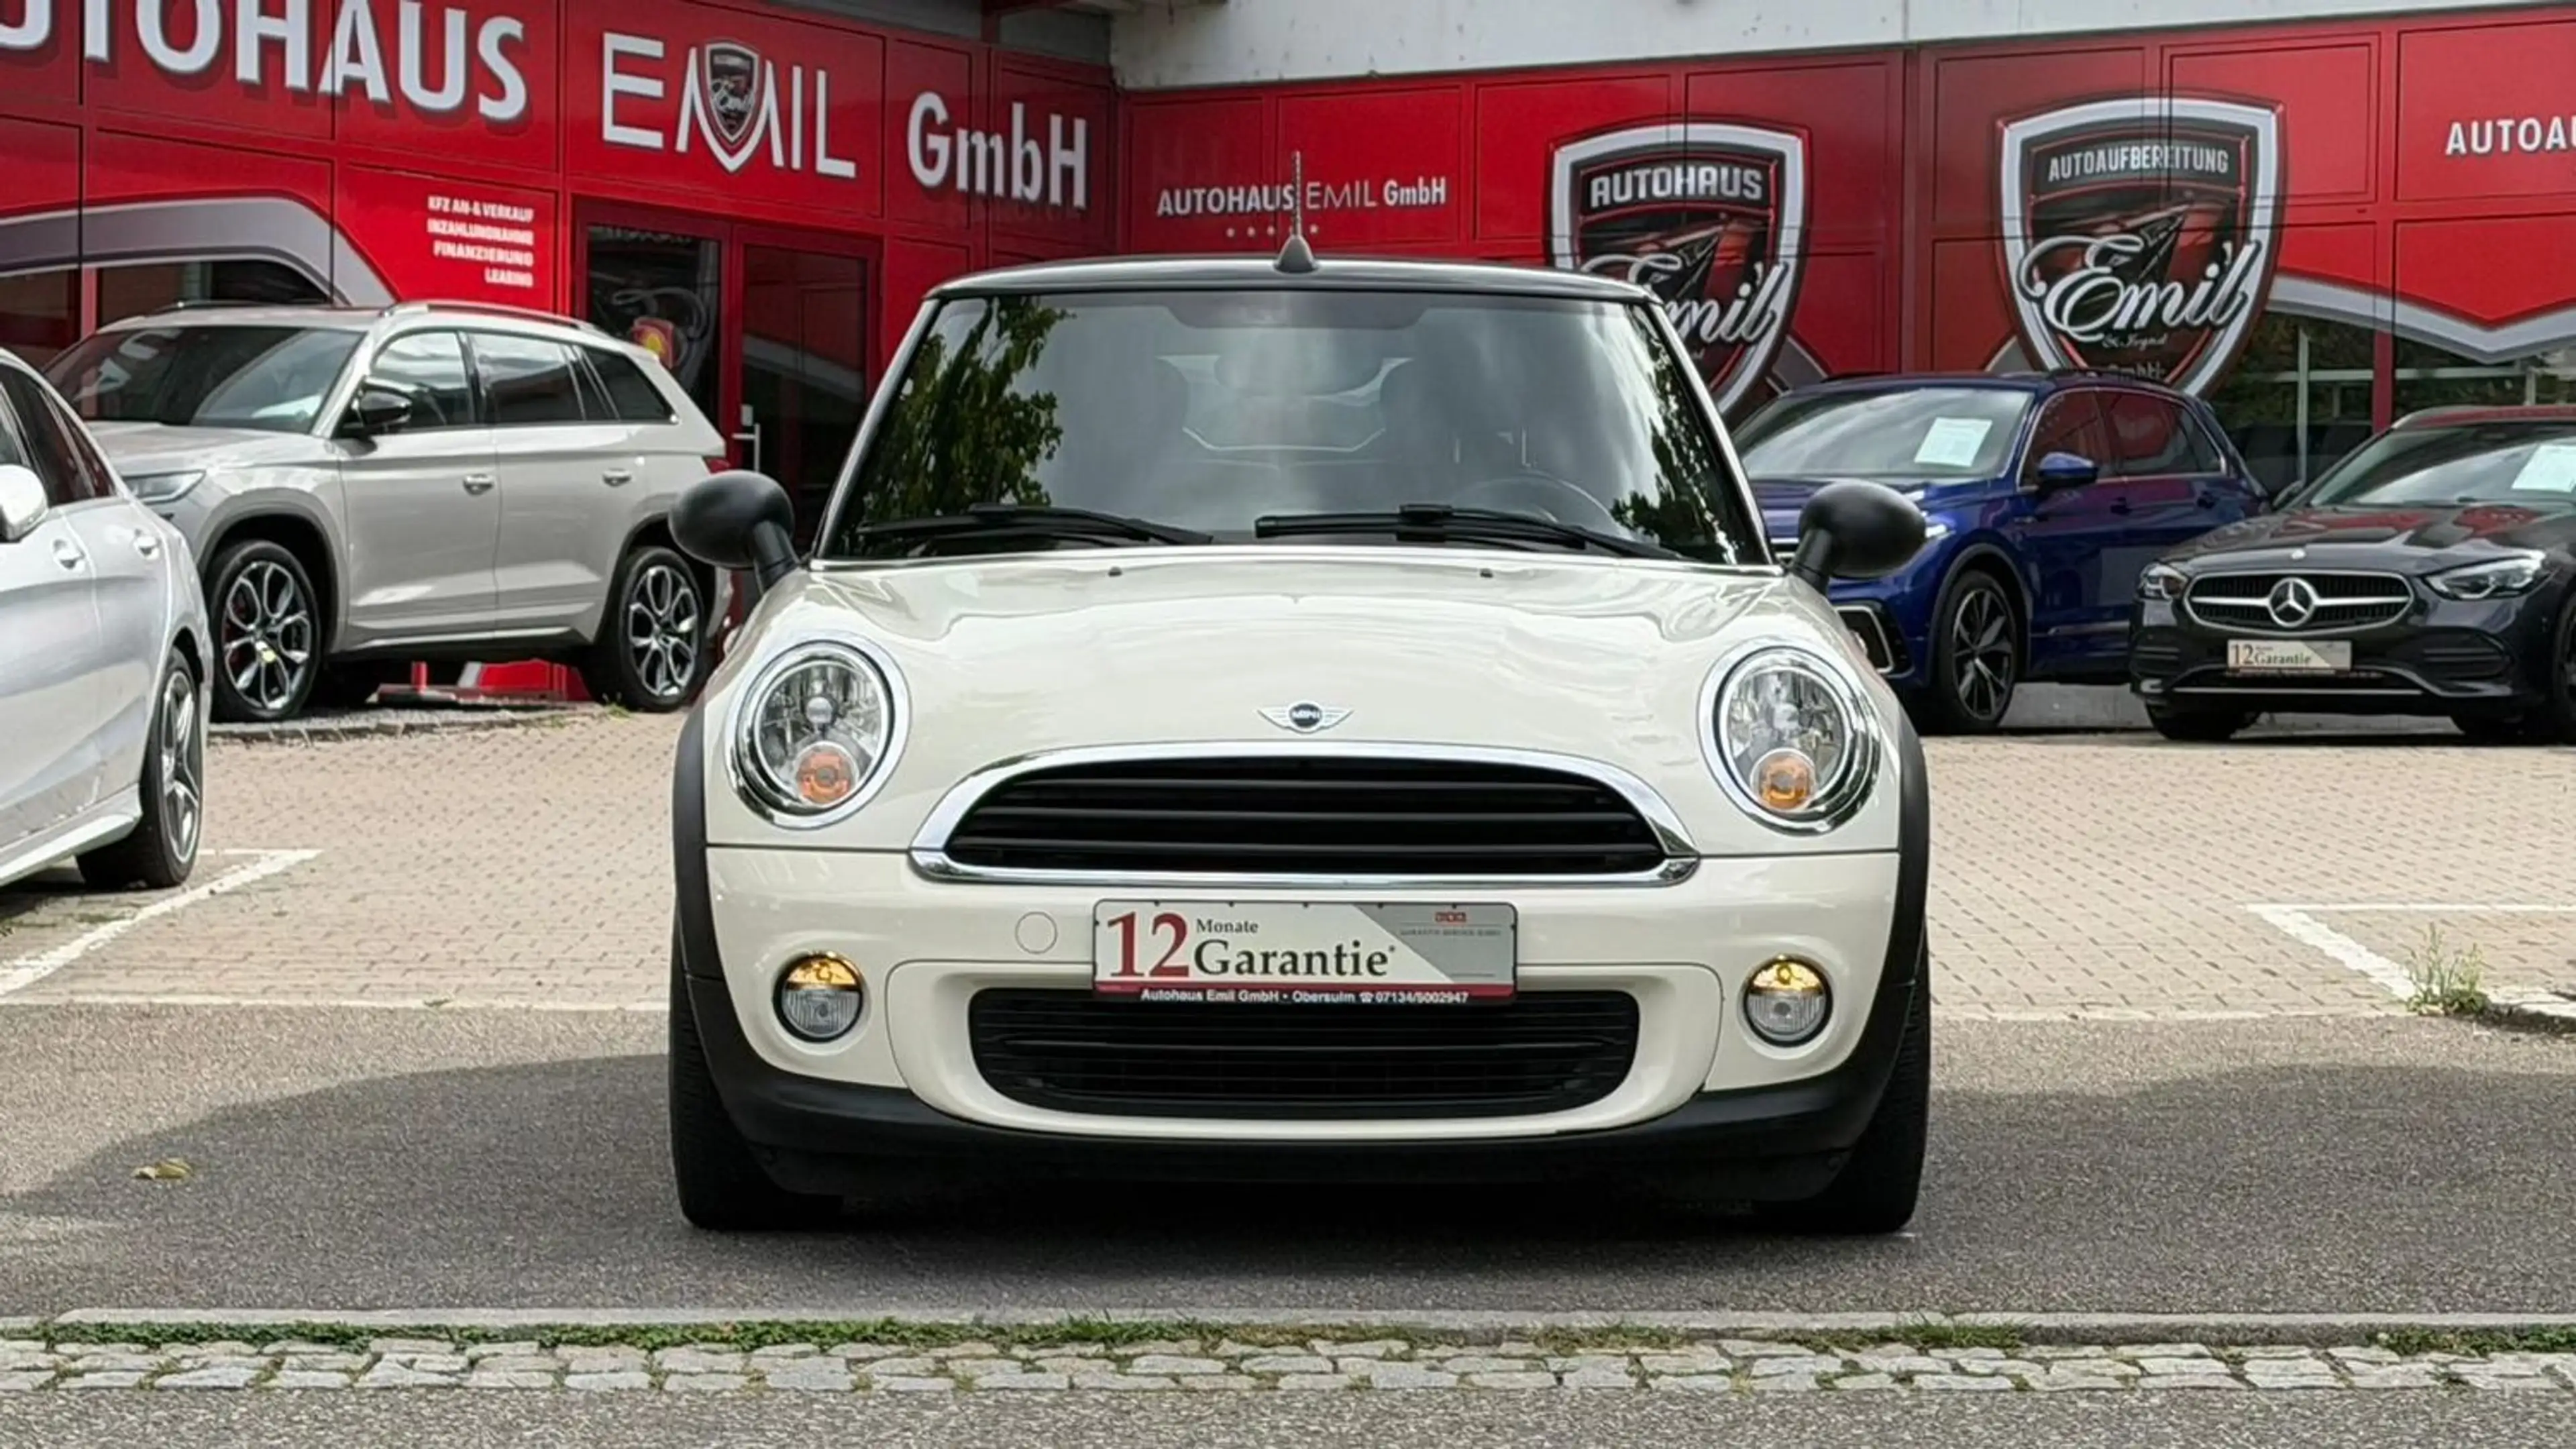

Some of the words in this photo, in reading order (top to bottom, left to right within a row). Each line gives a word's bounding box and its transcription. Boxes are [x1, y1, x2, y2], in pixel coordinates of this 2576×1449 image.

[602, 32, 857, 178] EMIL
[908, 91, 1088, 209] GmbH
[2446, 116, 2576, 156] AUTOA
[2048, 144, 2229, 182] AUTOAUFBEREITUNG
[1157, 184, 1295, 217] AUTOHAUS
[1306, 180, 1377, 209] EMIL
[1383, 176, 1447, 207] GmbH
[1591, 166, 1763, 209] AUTOHAUS
[427, 195, 451, 213] KFZ
[482, 202, 534, 223] VERKAUF
[433, 239, 534, 267] FINANZIERUNG
[484, 266, 534, 288] LEASING
[2020, 235, 2257, 343] Emil
[2231, 643, 2253, 665] 12
[2254, 653, 2312, 665] Garantie
[1108, 911, 1189, 977] 12
[1196, 918, 1258, 933] Monate
[1140, 989, 1204, 1002] Autohaus
[1208, 990, 1235, 1002] Emil
[1238, 991, 1279, 1002] GmbH
[1292, 990, 1356, 1003] Obersulm
